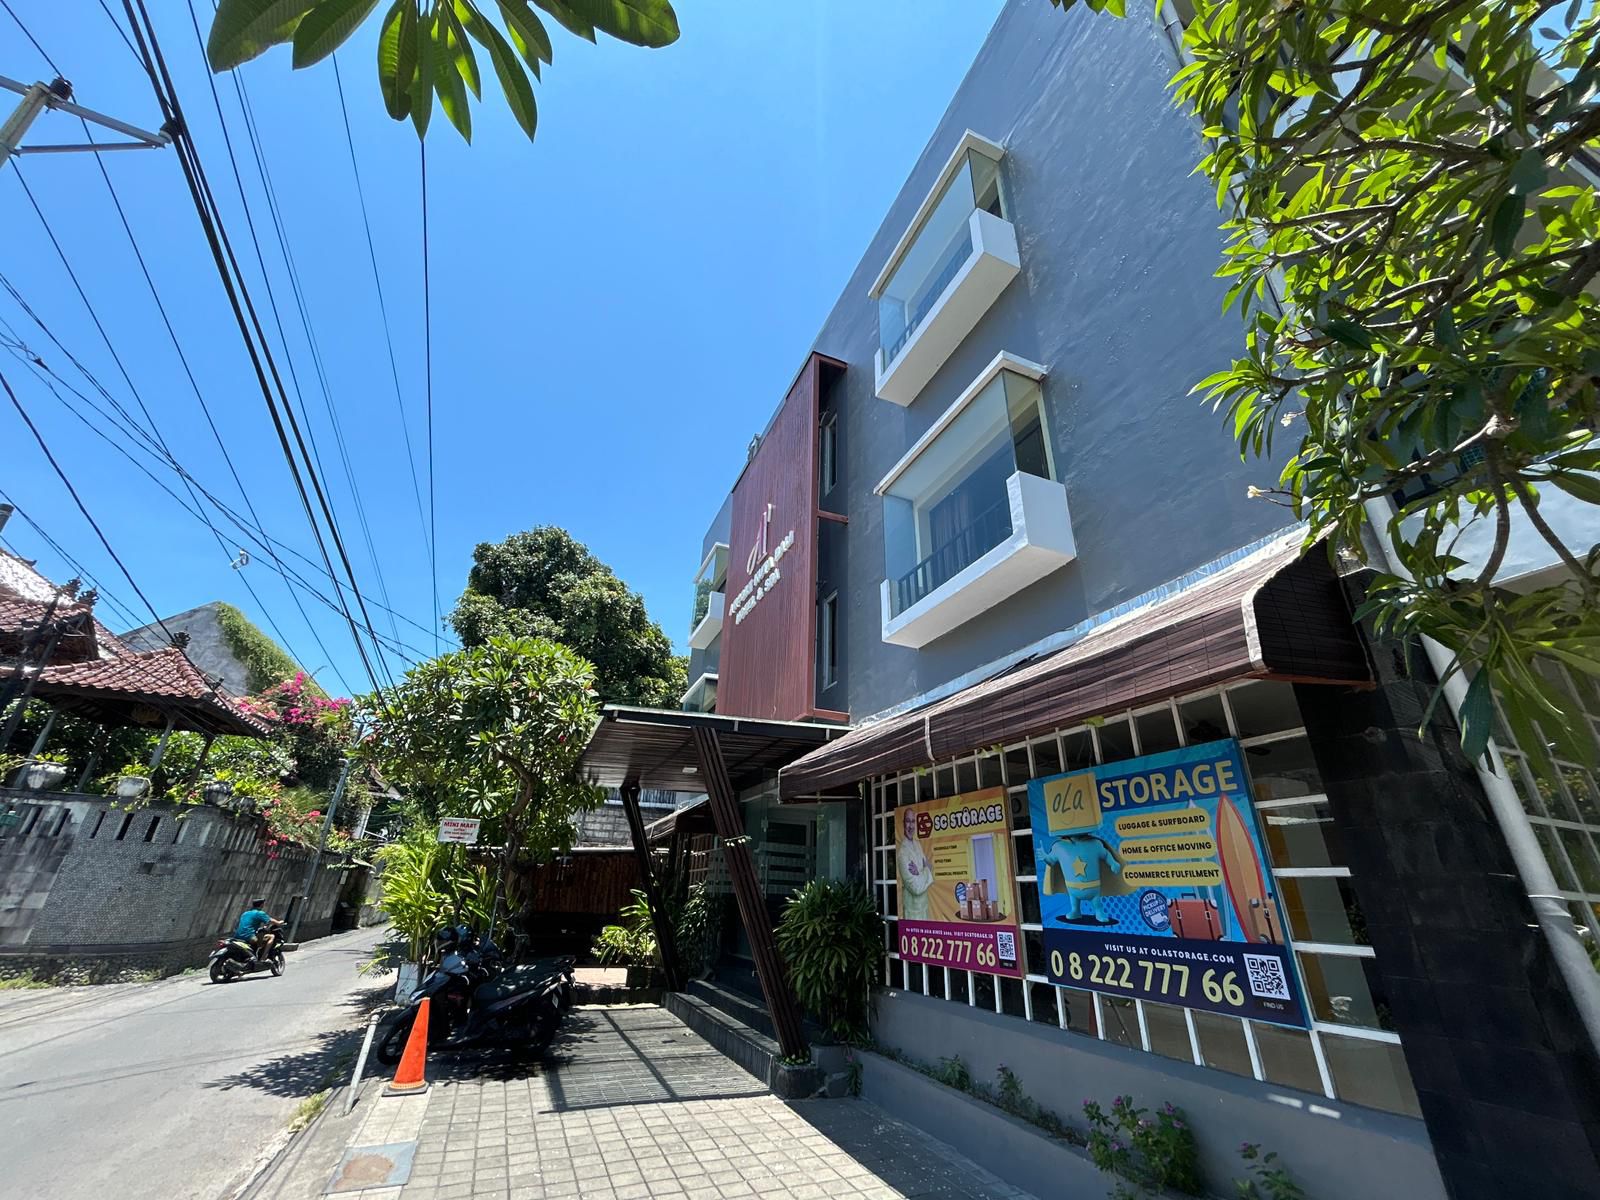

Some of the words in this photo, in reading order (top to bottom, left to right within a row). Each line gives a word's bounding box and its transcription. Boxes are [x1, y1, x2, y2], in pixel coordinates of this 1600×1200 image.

[1100, 759, 1238, 809] STORAGE
[934, 814, 948, 831] SC
[950, 804, 1004, 829] STORAGE
[1118, 819, 1150, 831] LUGGAGE
[1151, 817, 1158, 828] &
[1158, 814, 1206, 826] SURFBOARD
[1121, 844, 1142, 855] HOME
[1143, 843, 1149, 854] &
[1150, 842, 1177, 853] OFFICE
[1177, 840, 1212, 852] MOVING
[1123, 869, 1170, 880] ECOMMERCE
[1170, 867, 1220, 879] FULFILMENT
[1145, 903, 1166, 918] DELIVERY
[901, 934, 909, 955] 0
[911, 936, 919, 956] 8
[921, 936, 944, 960] 222
[946, 939, 972, 963] 777
[976, 942, 996, 967] 66
[1104, 943, 1124, 953] VISIT
[1126, 945, 1137, 955] US
[1139, 947, 1148, 956] AT
[1150, 947, 1235, 964] OLASTORAGE.COM
[1050, 949, 1064, 977] 0
[1068, 952, 1083, 980] 8
[1087, 954, 1134, 989] 222
[1138, 959, 1190, 998] 777
[1201, 968, 1245, 1006] 66
[1263, 1001, 1275, 1010] FIND
[1276, 1002, 1285, 1010] US
